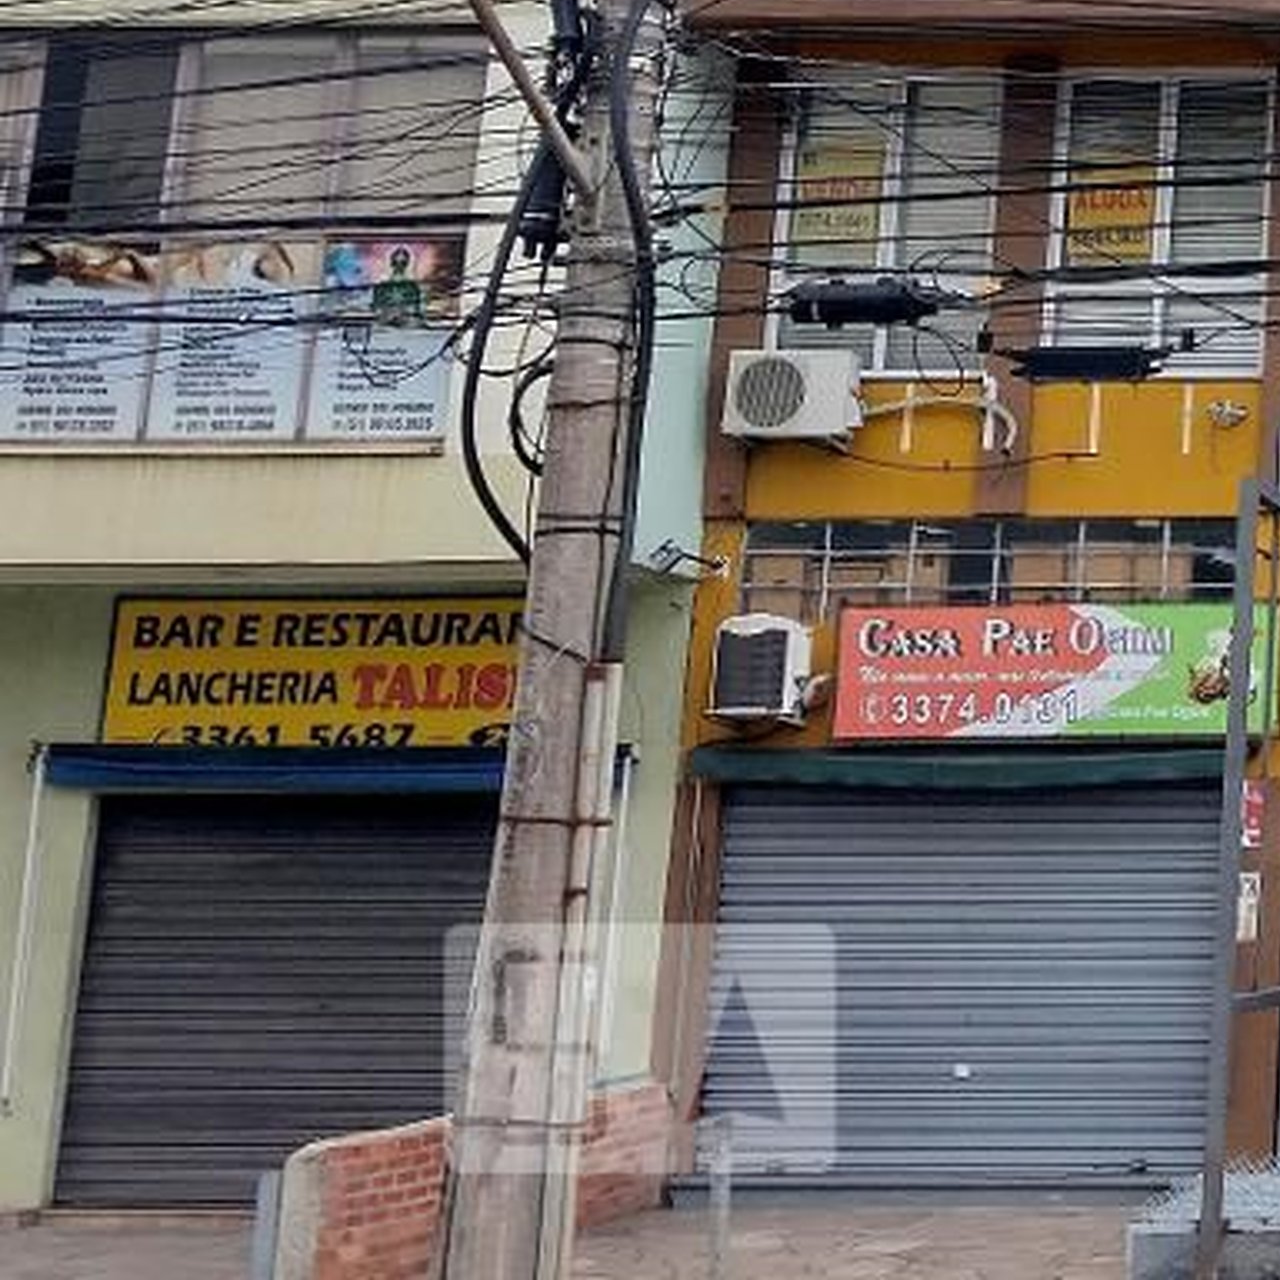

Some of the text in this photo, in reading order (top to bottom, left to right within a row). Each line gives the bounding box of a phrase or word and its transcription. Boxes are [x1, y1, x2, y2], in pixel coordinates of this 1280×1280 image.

[133, 613, 225, 649] BAR
[234, 613, 261, 647] E
[128, 662, 518, 710] LANCHERIA TALIS
[181, 723, 415, 747] 3361 5687
